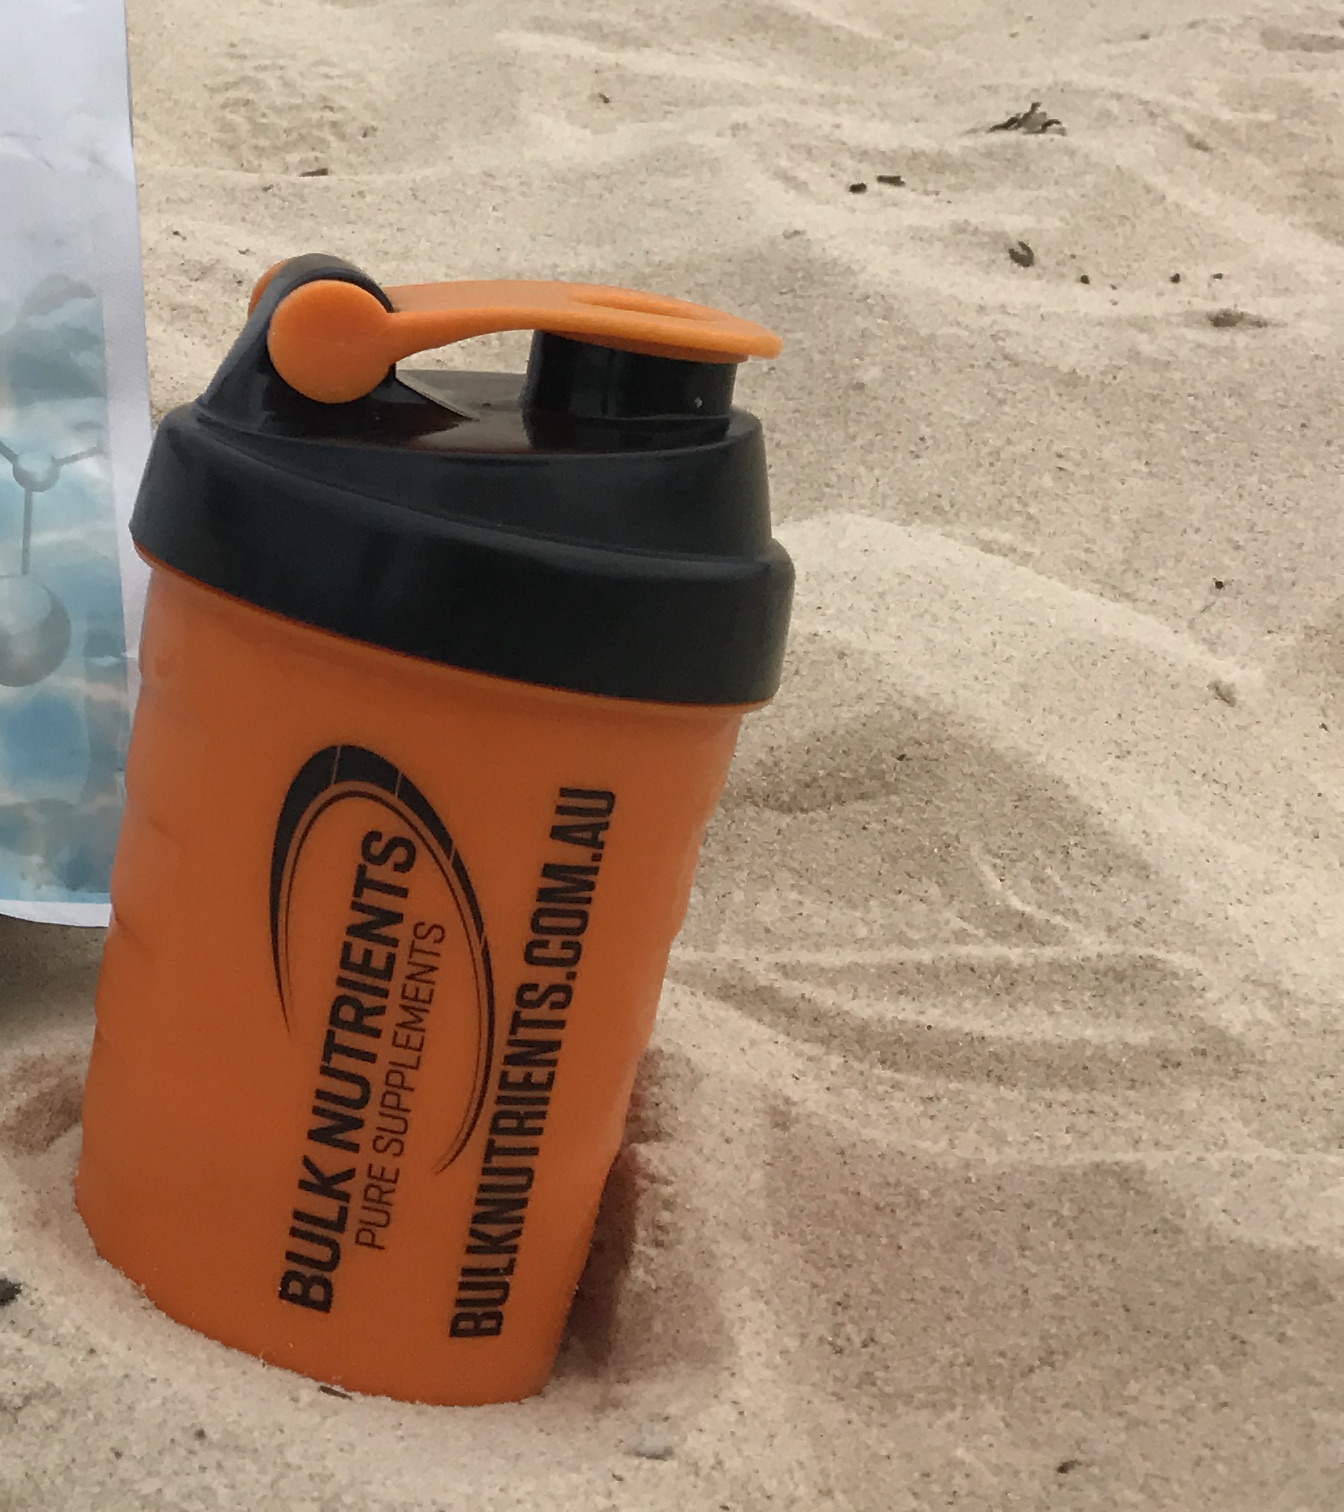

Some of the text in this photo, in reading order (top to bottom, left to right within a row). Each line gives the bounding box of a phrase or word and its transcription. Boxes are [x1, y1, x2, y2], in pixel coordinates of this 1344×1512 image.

[278, 829, 417, 1314] BULK NUTRIENTS
[357, 921, 447, 1251] PURE SUPPLEMENTS
[450, 787, 616, 1341] BULKNUTRIENTS.COM.AU
